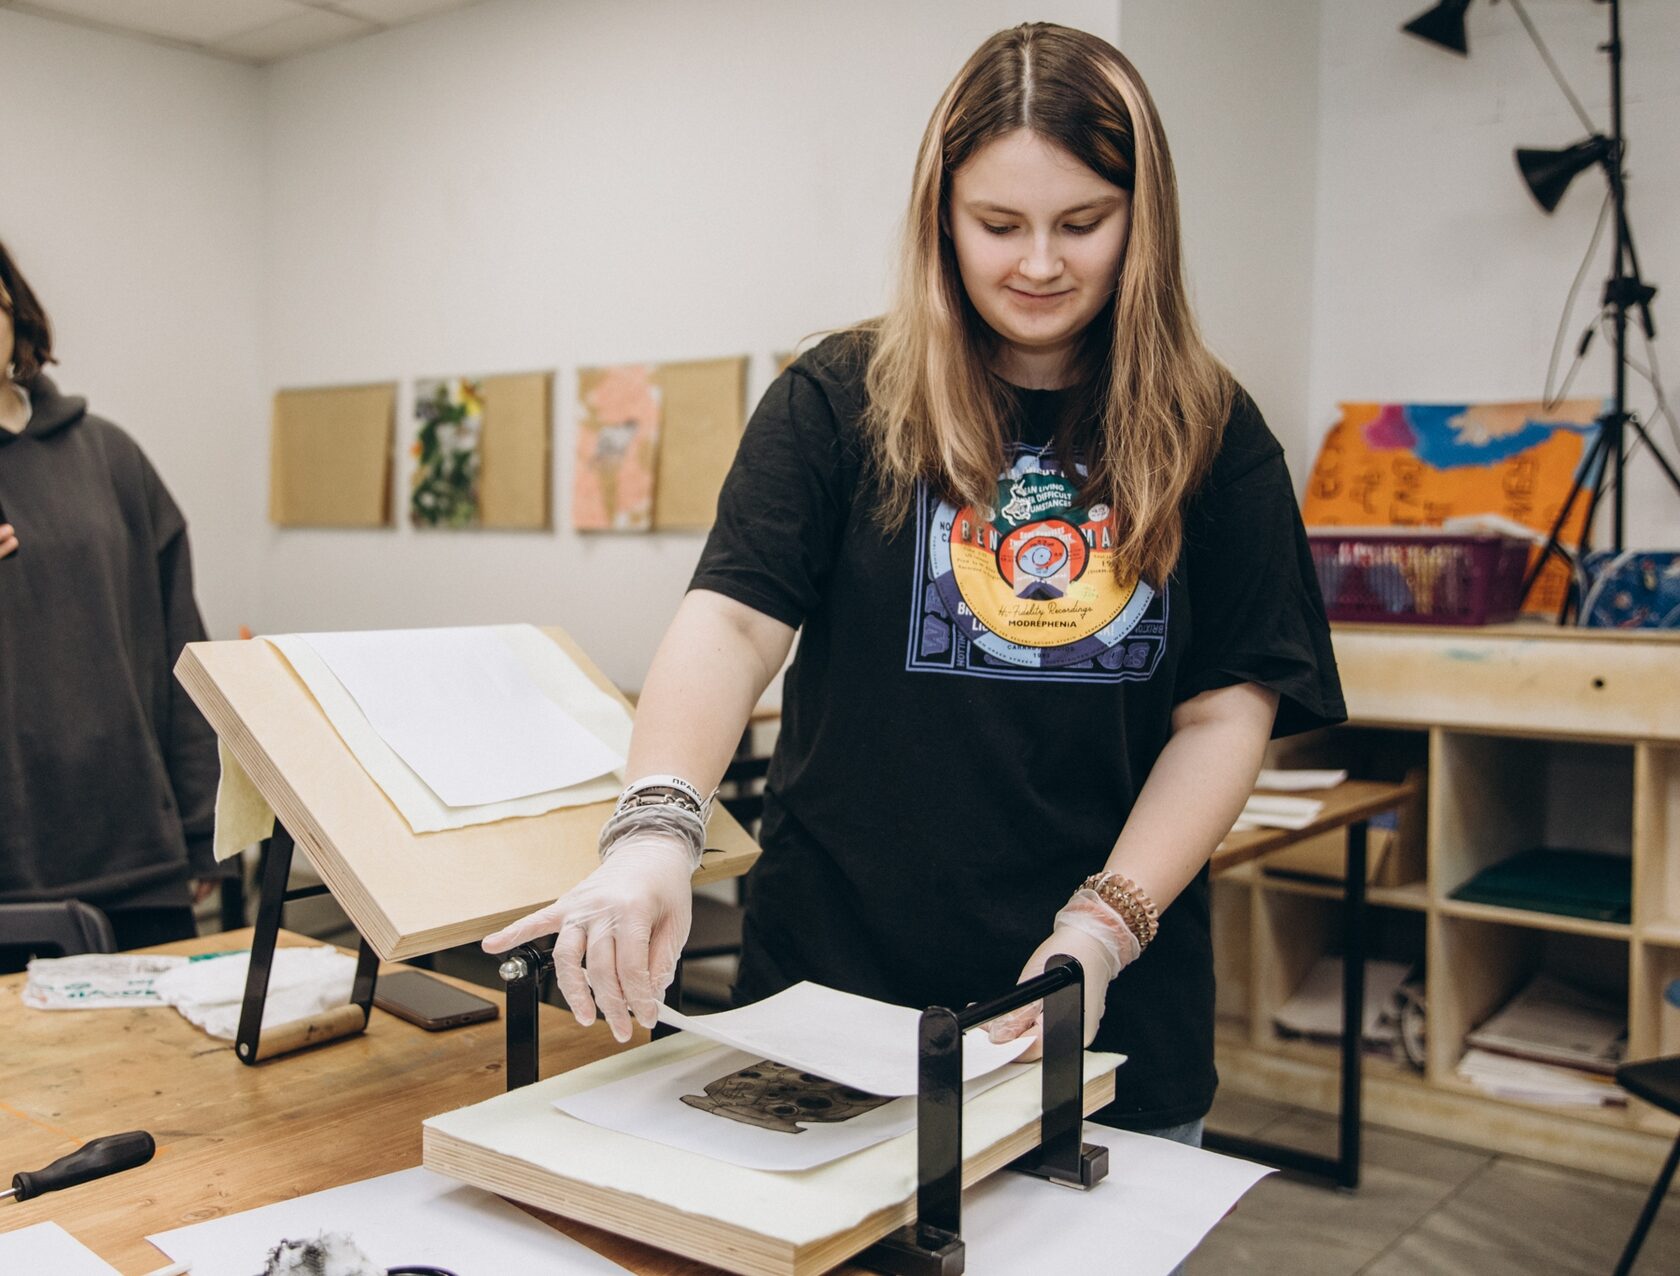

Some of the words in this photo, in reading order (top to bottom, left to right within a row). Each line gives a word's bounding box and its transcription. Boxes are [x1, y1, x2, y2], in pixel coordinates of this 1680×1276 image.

[1038, 483, 1065, 492] LIVING
[1036, 492, 1072, 503] DIFFICULT
[1031, 499, 1073, 514] UMSTANCES
[1047, 600, 1094, 619] Recordings
